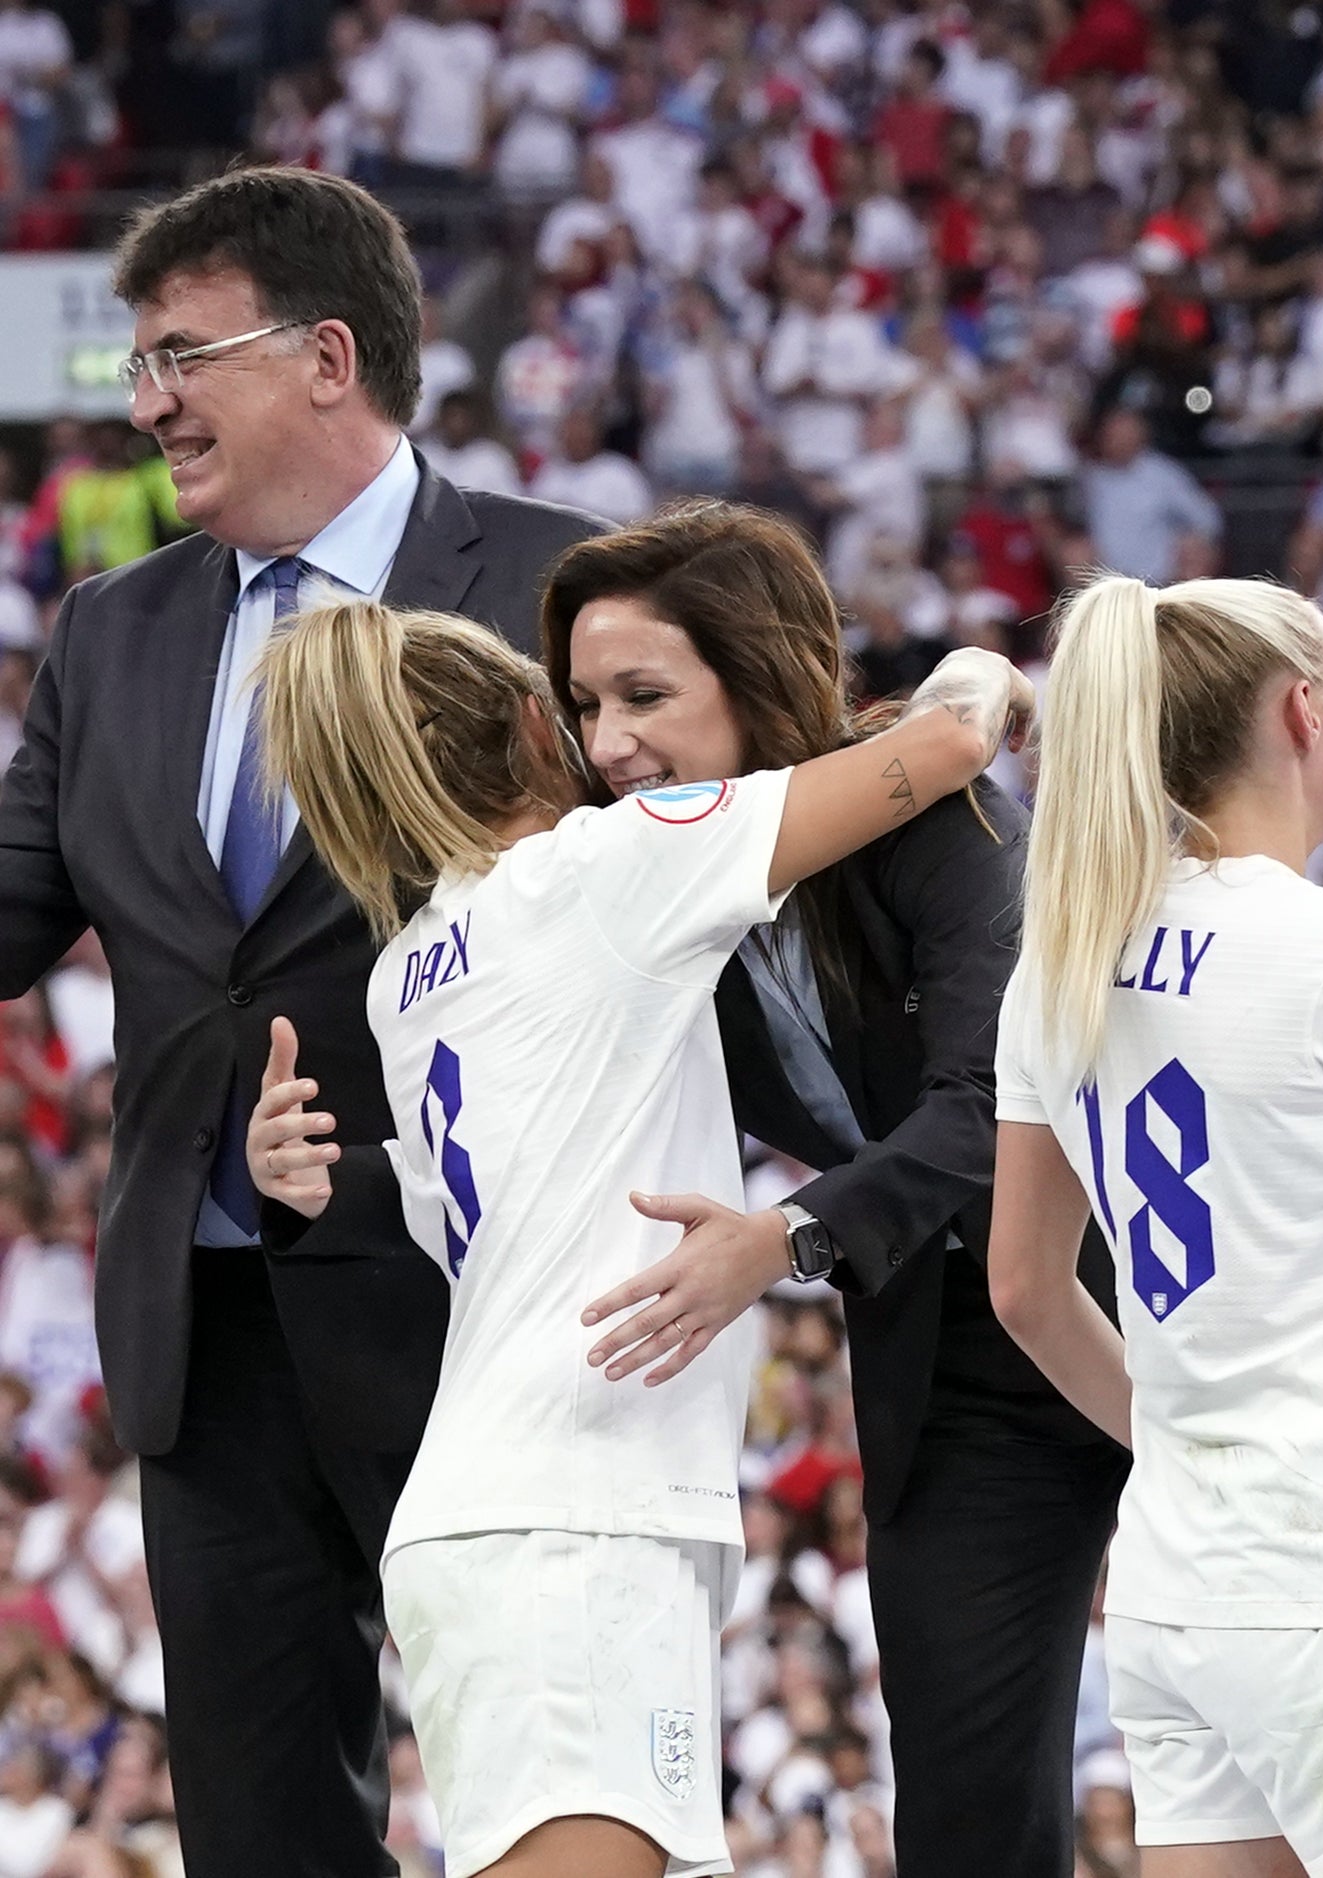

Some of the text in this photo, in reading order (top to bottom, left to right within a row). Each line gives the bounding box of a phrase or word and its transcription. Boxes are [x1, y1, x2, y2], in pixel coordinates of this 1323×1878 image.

[399, 908, 471, 1014] DALY
[1109, 926, 1217, 996] LLY
[1075, 1056, 1216, 1324] 18
